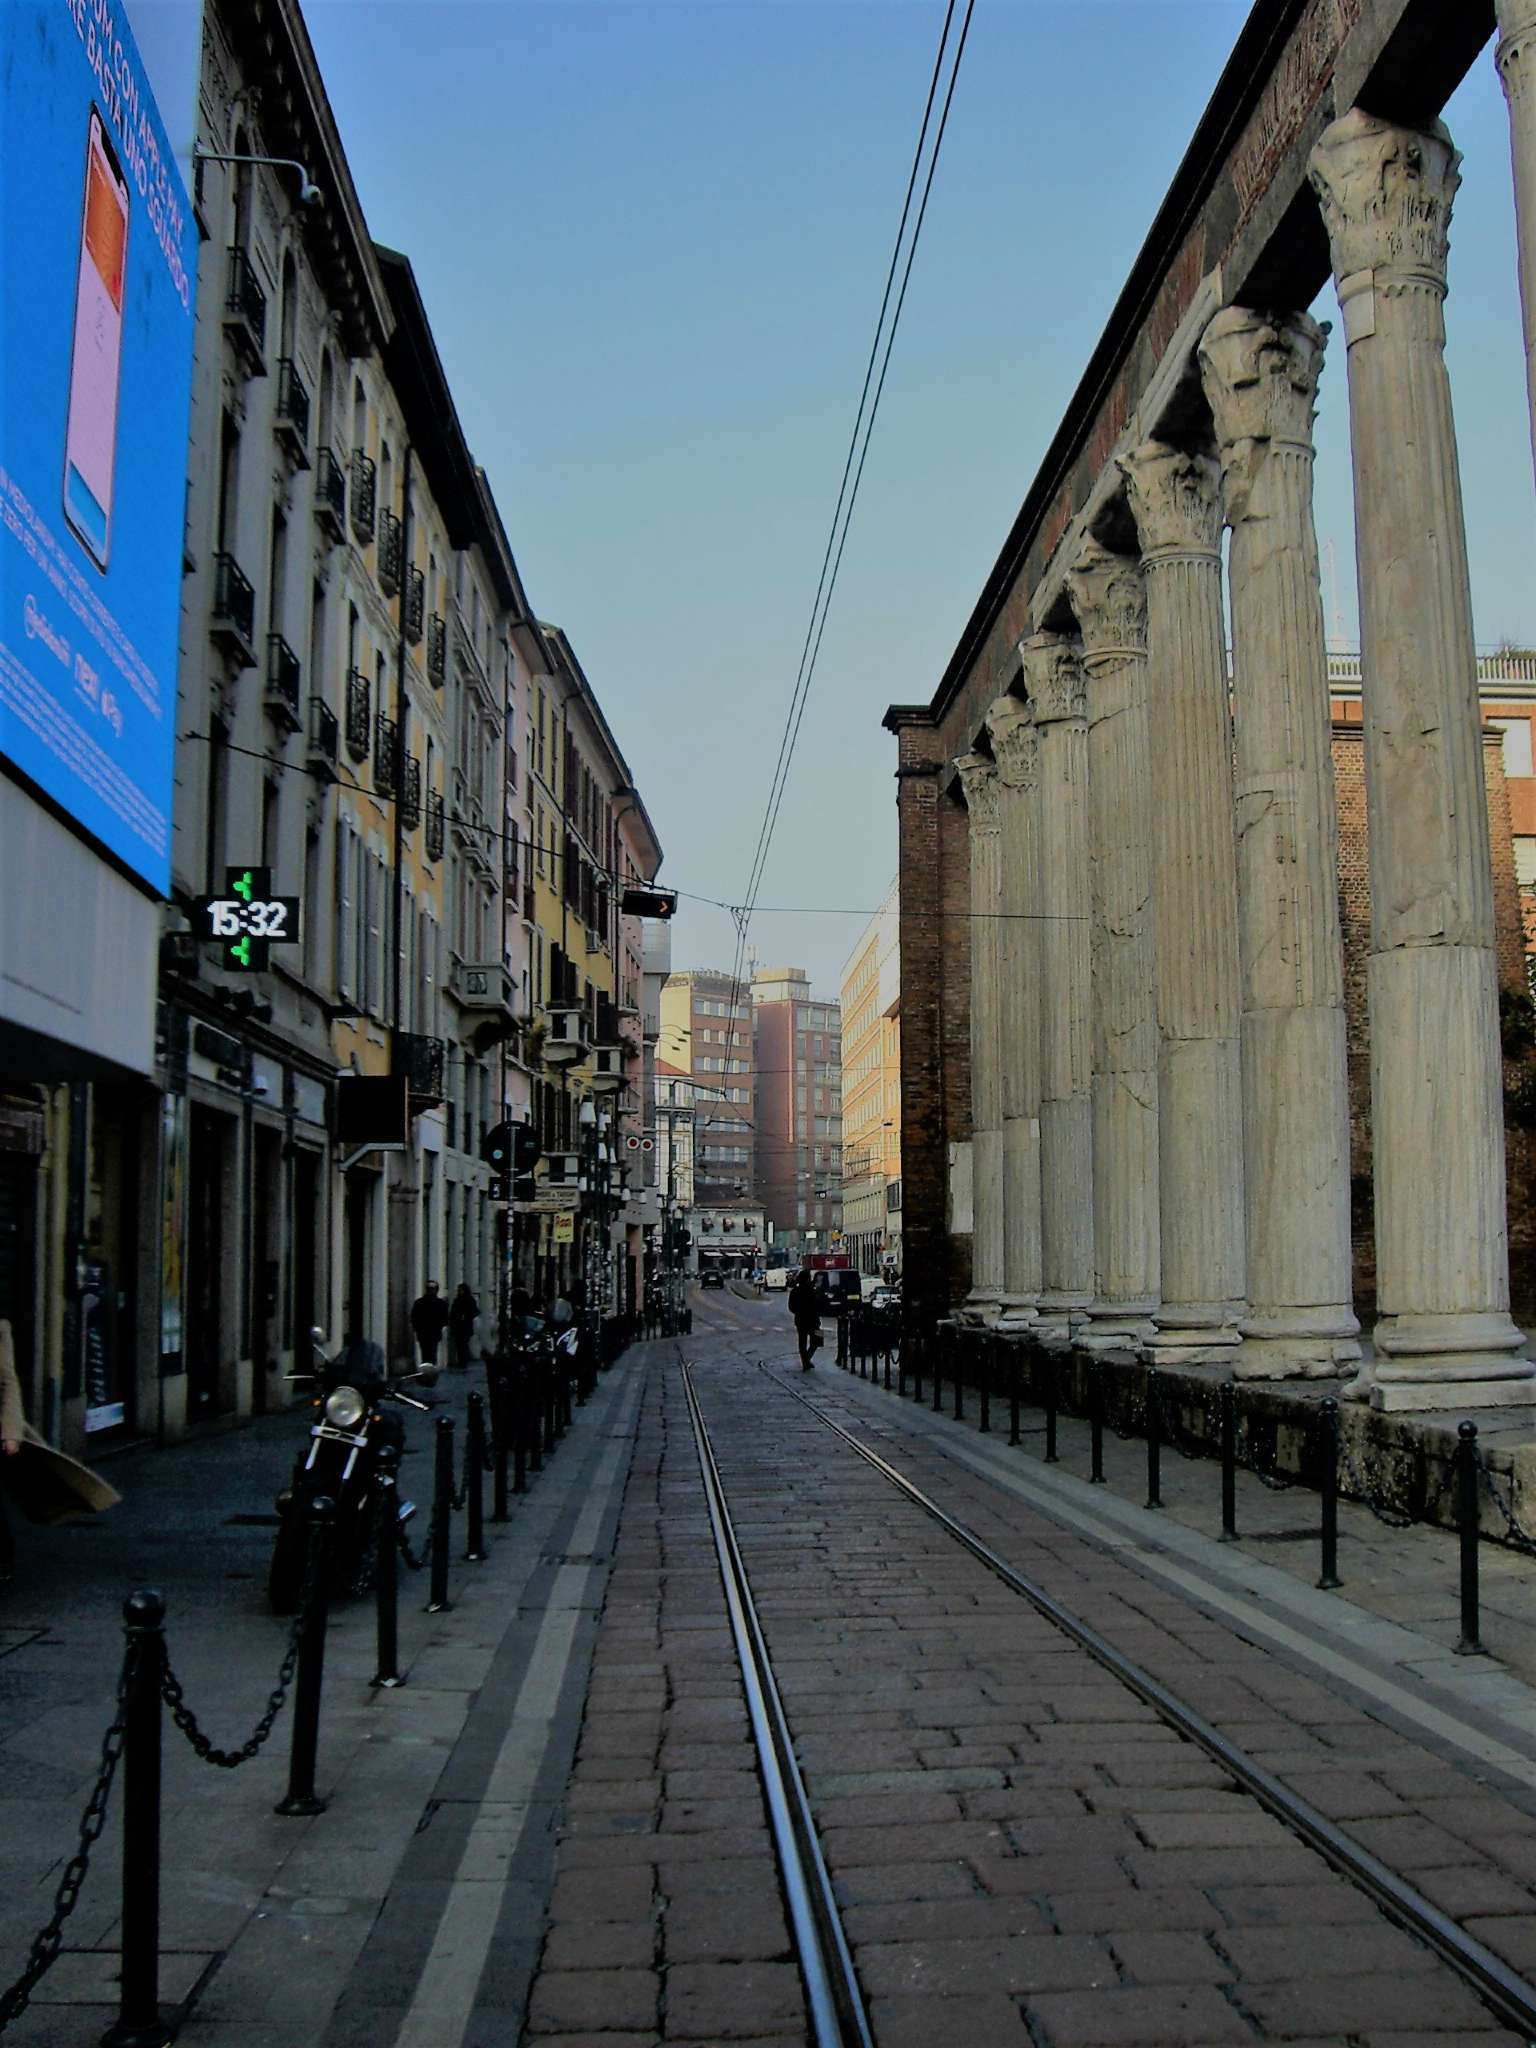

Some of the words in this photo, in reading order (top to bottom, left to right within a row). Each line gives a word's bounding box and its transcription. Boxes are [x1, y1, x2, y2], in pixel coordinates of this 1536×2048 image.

[86, 18, 121, 139] BASTA
[123, 114, 147, 197] UNO
[114, 41, 138, 126] CON
[139, 111, 167, 205] APPLE
[206, 900, 288, 937] 15:32
